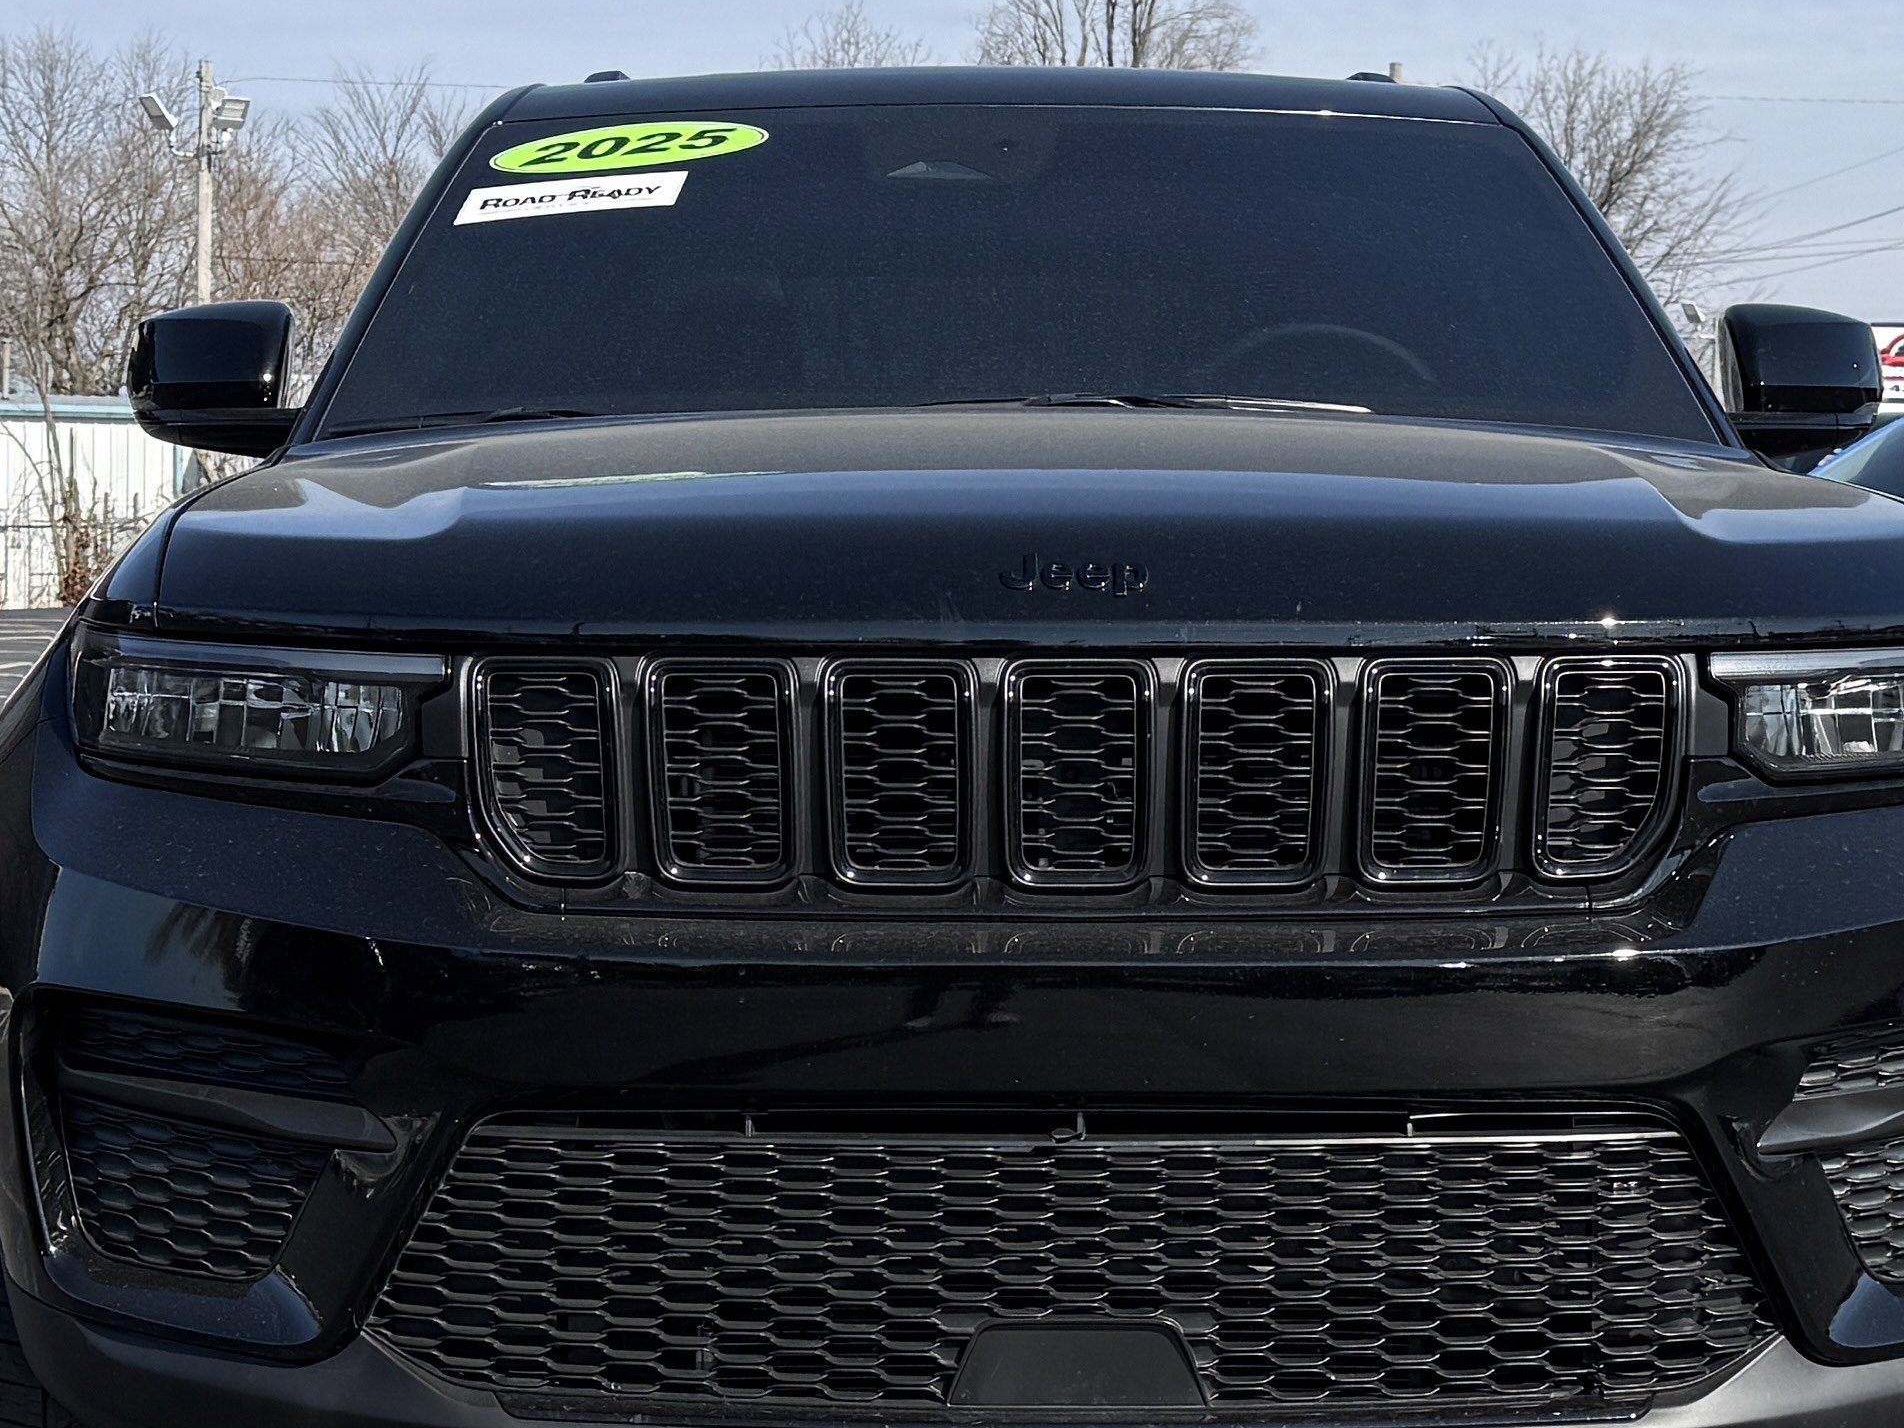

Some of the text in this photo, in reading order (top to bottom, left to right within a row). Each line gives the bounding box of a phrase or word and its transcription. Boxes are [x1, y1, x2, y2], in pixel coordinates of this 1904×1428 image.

[518, 127, 738, 168] 2025
[479, 194, 558, 211] ROAD
[998, 551, 1149, 598] Jeep
